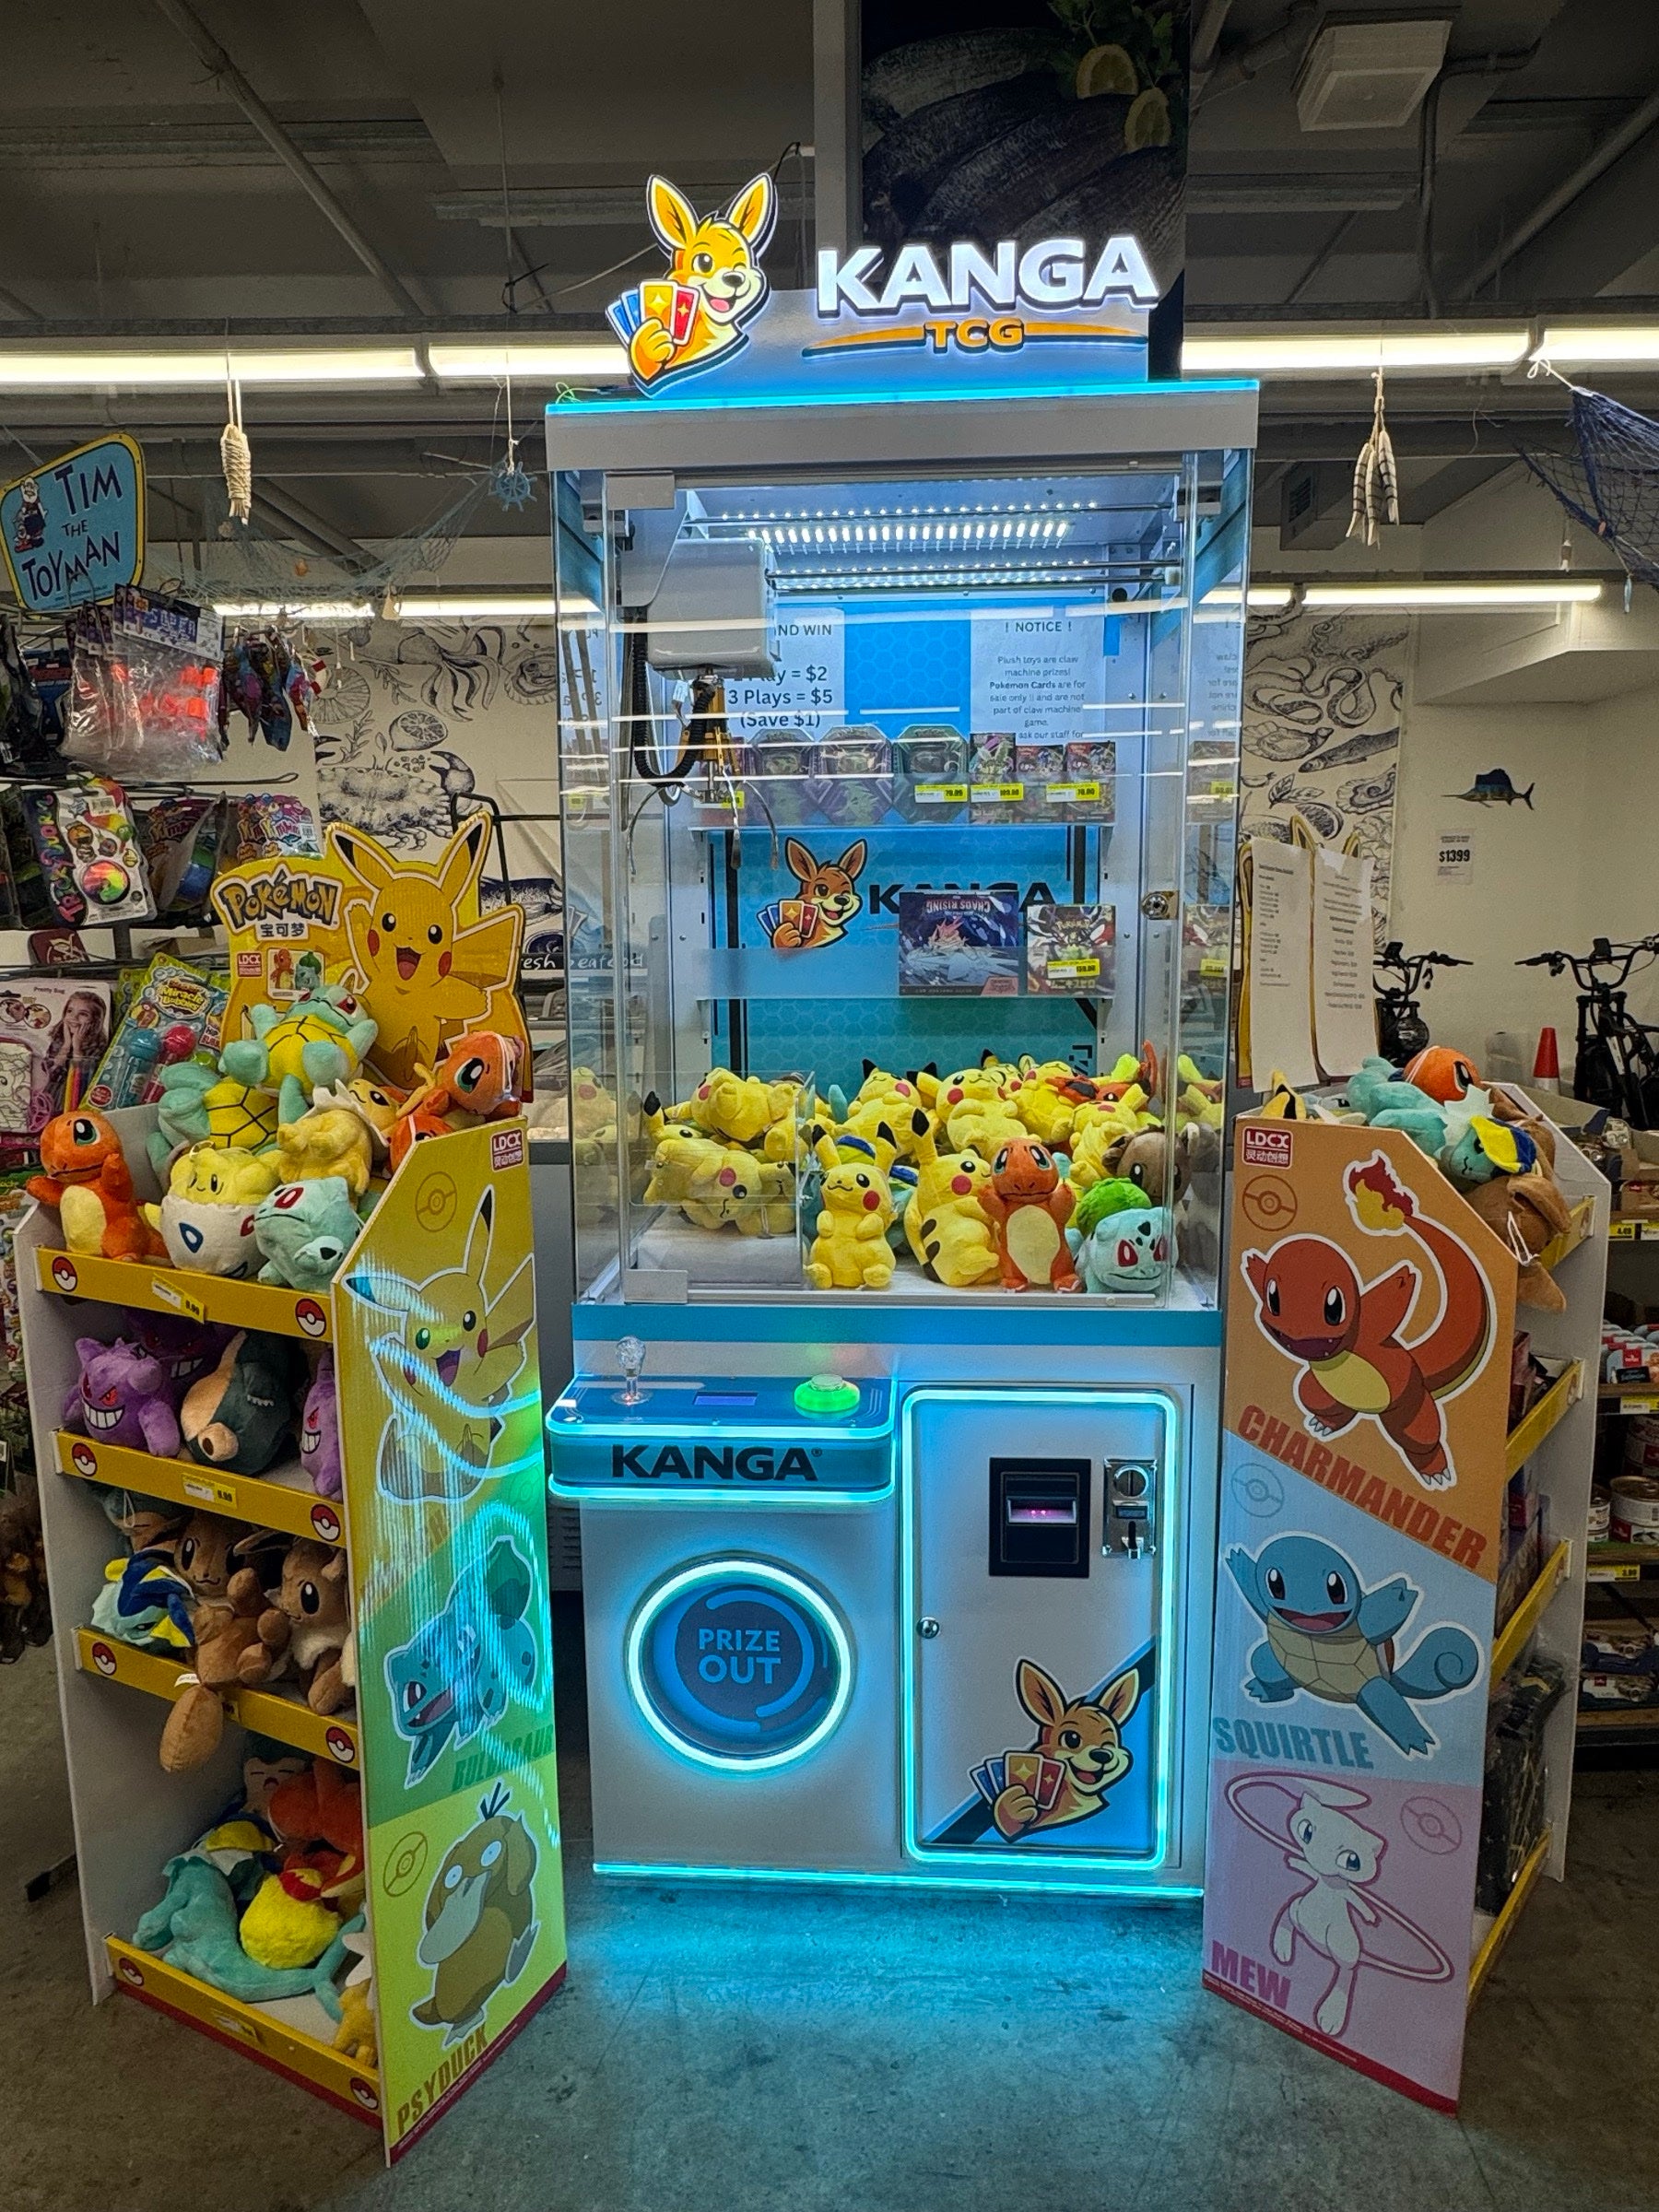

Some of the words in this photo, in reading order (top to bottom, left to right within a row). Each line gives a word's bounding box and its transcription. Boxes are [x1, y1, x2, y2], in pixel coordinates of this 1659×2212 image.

[818, 235, 1158, 316] KANGA
[924, 319, 1025, 352] TCG
[54, 464, 124, 516] TIM
[61, 519, 88, 537] THE
[21, 531, 121, 601] TOYMAN
[775, 624, 799, 635] ND
[804, 624, 832, 635] WIN
[1015, 621, 1062, 632] NOTICE
[1023, 656, 1041, 666] toys
[806, 665, 828, 682] $2
[1005, 668, 1041, 677] machine
[1030, 681, 1056, 689] Cards
[1073, 680, 1086, 688] for
[728, 690, 738, 704] 3
[745, 690, 791, 708] Plays
[810, 688, 832, 706] $5
[1008, 694, 1027, 703] only
[1036, 693, 1053, 701] and
[993, 706, 1011, 715] part
[1024, 705, 1042, 713] claw
[1045, 705, 1081, 713] machine
[740, 712, 789, 729] (Save
[794, 711, 820, 728] $1)
[1024, 719, 1049, 727] game.
[1051, 730, 1069, 738] staff
[1439, 849, 1470, 863] $1399
[926, 900, 958, 913] RISING
[959, 900, 991, 912] CHAOS
[260, 923, 305, 938] 宝可梦
[569, 953, 644, 970] eafood
[493, 1133, 522, 1152] LDCX
[1246, 1130, 1289, 1148] LDCX
[1238, 1405, 1488, 1570] CHARMANDER
[699, 1629, 781, 1652] PRIZE
[698, 1654, 782, 1684] OUT
[1213, 1716, 1374, 1770] SQUIRTLE
[1211, 1939, 1290, 2011] MEW
[397, 2021, 488, 2136] PSYDUCK
